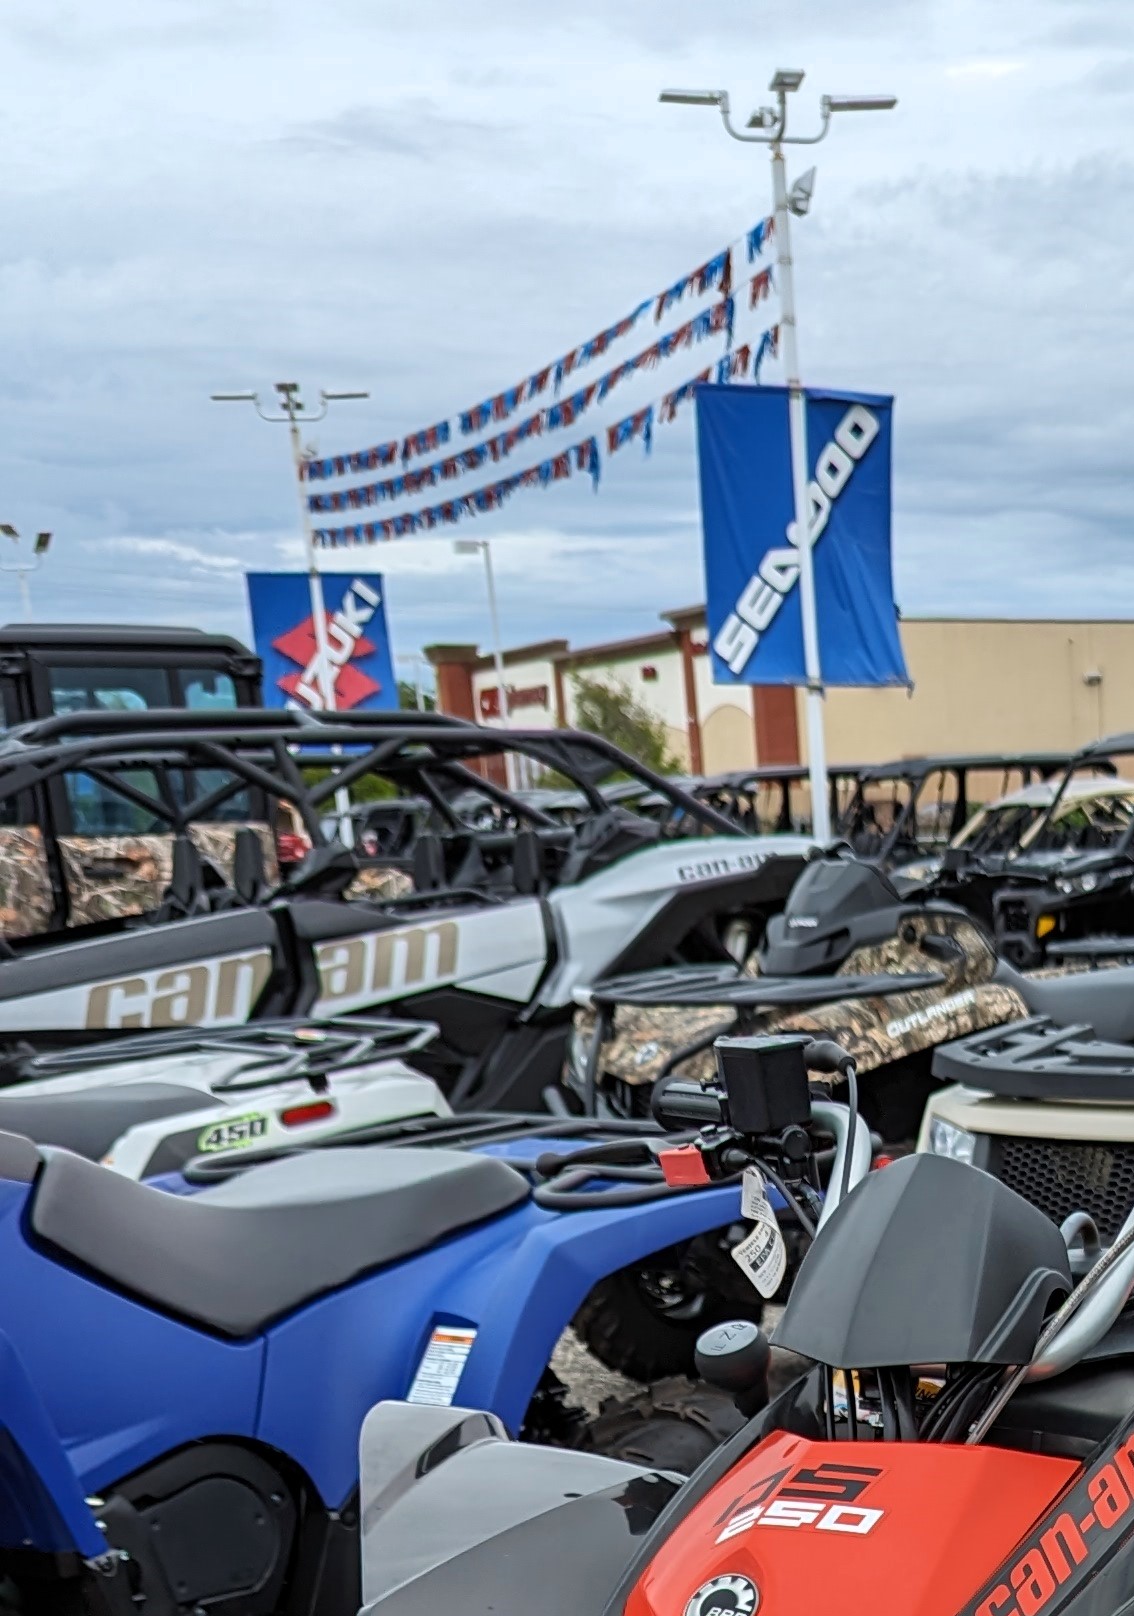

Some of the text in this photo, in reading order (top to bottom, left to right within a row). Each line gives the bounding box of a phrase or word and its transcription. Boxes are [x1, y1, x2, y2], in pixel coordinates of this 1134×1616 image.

[886, 989, 976, 1039] OUTLANDER
[205, 1118, 267, 1144] 450
[714, 1499, 886, 1546] 250
